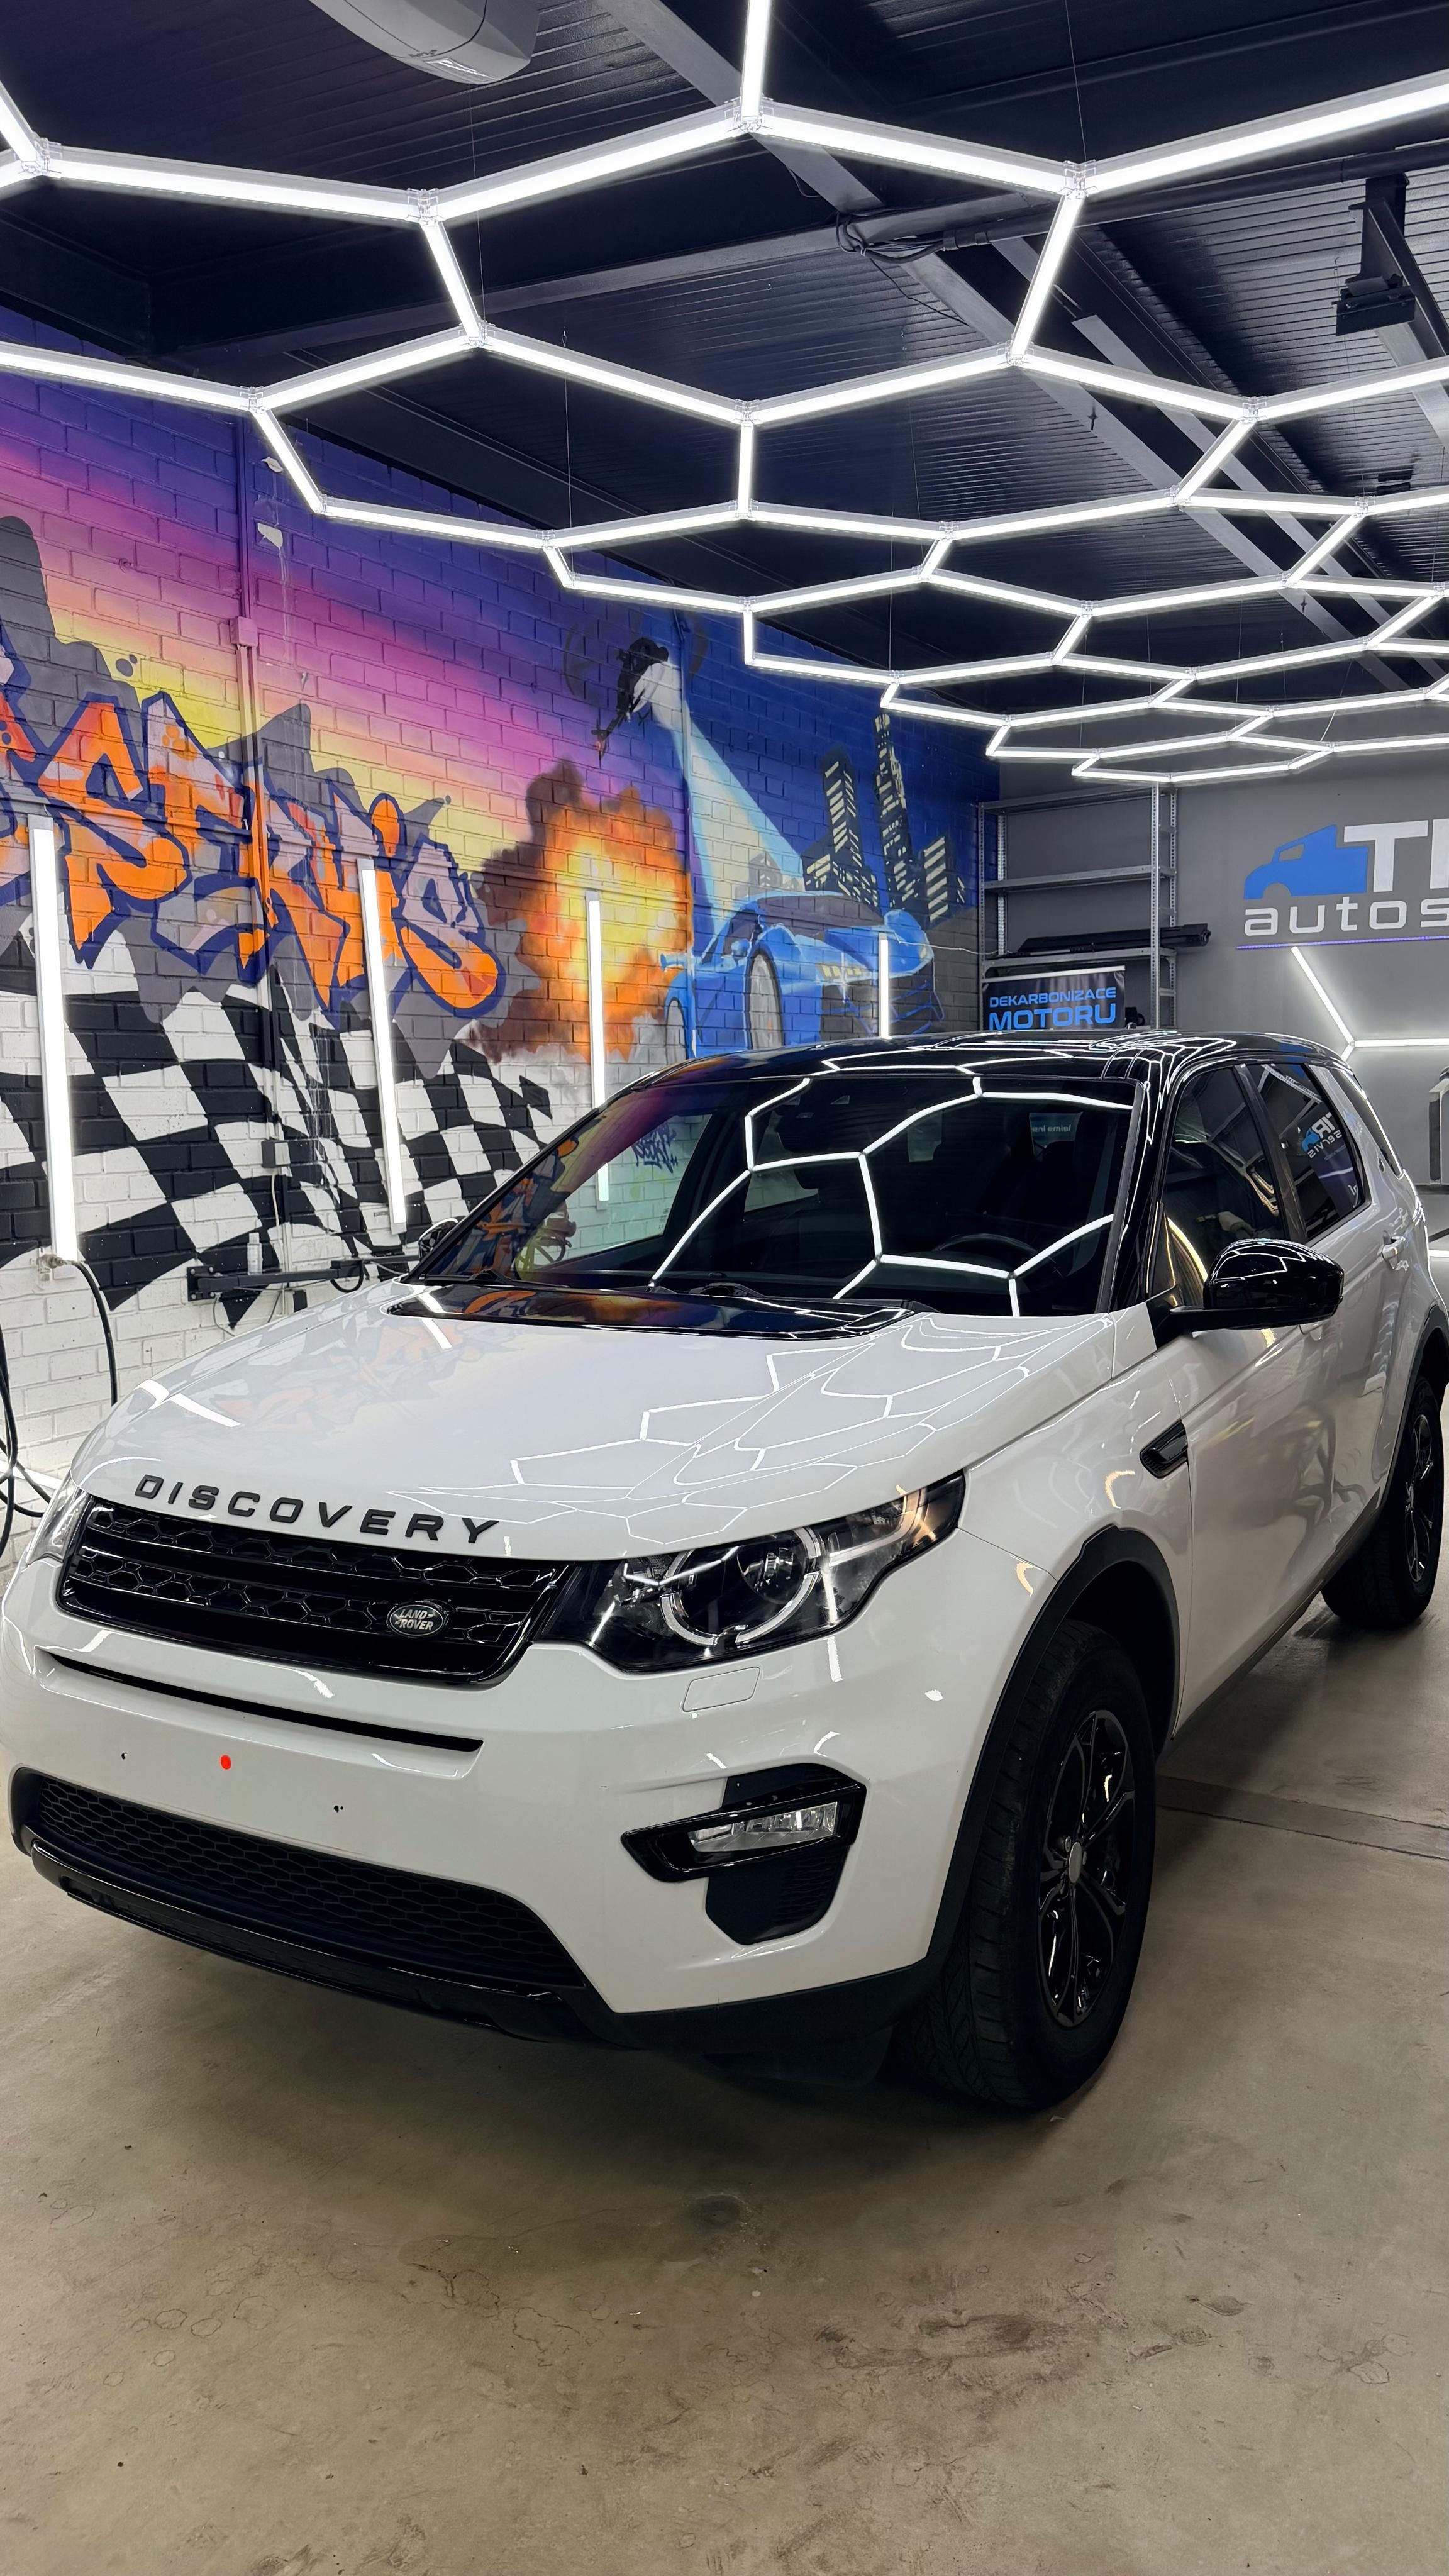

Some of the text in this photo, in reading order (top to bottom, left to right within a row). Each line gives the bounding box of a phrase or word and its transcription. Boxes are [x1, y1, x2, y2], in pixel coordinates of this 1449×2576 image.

[989, 987, 1117, 1008] DEKARBONIZACE
[989, 1003, 1116, 1031] MOTORU
[134, 1474, 499, 1544] DISCOVERY
[399, 1619, 434, 1631] ROVER
